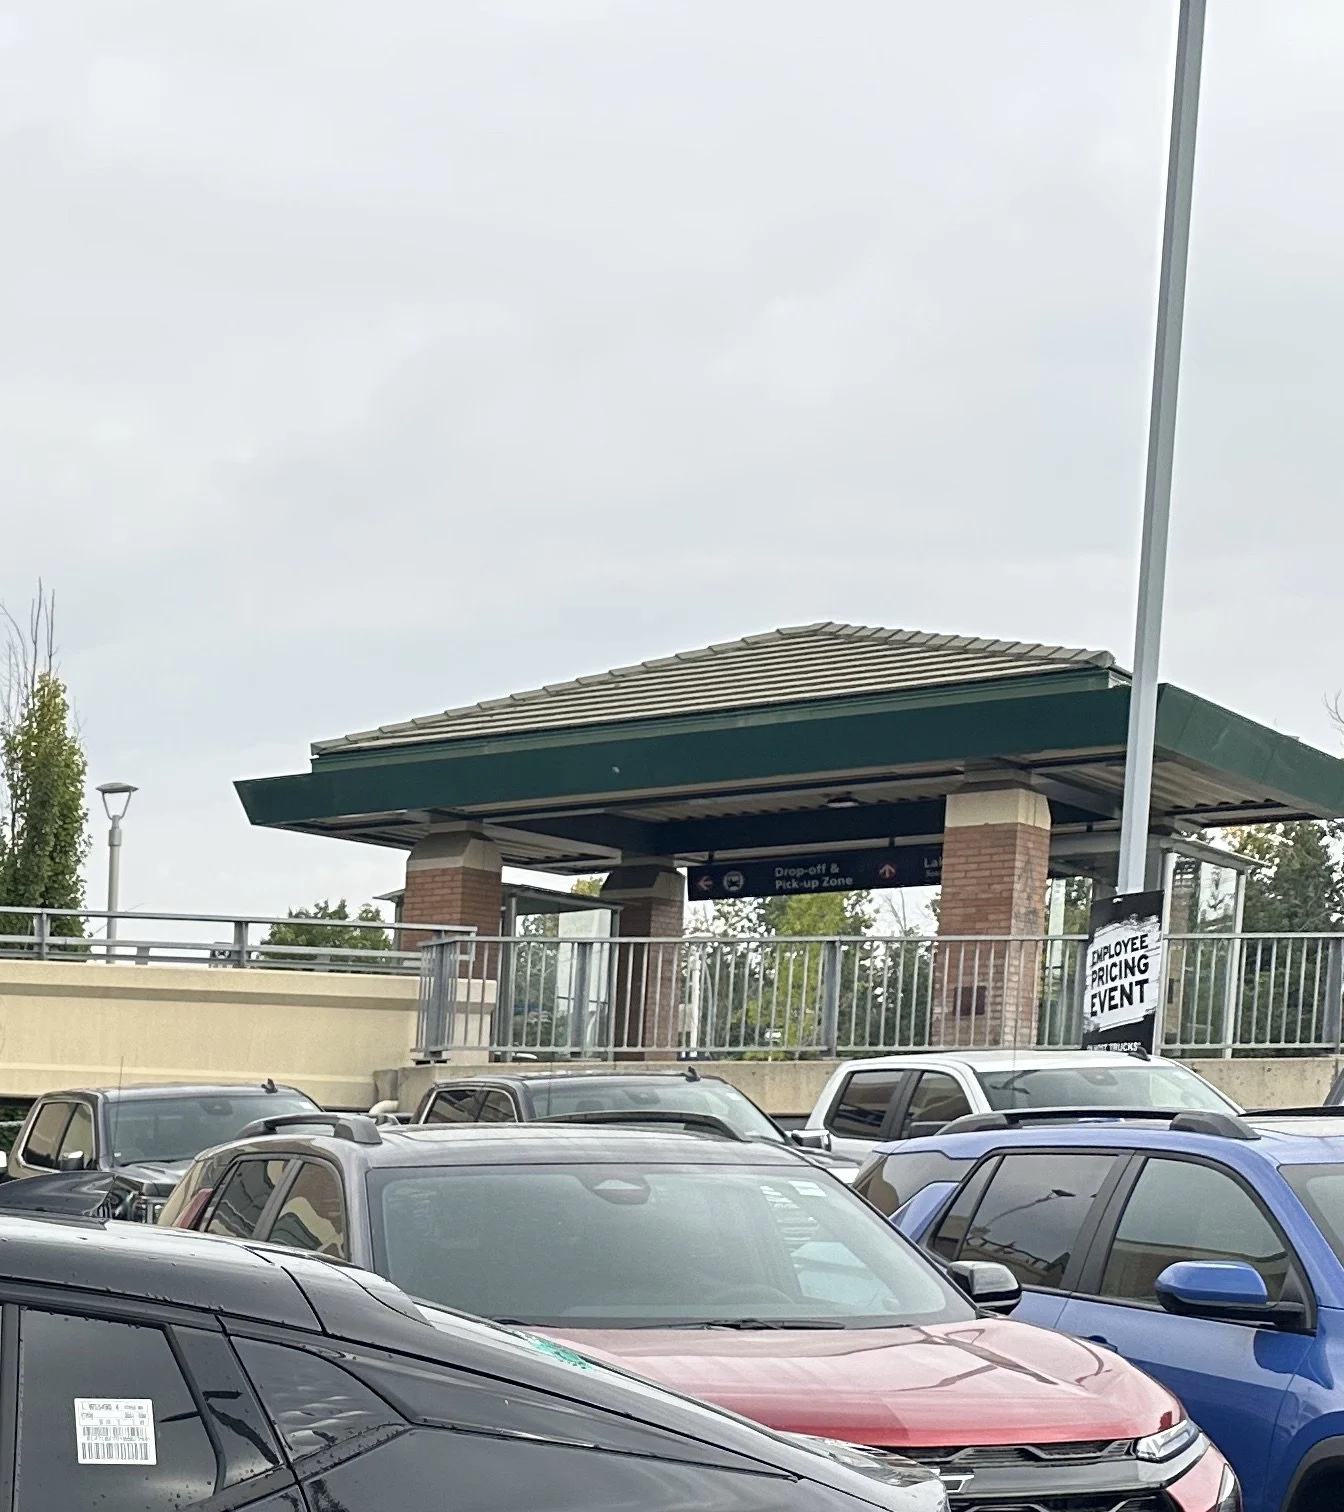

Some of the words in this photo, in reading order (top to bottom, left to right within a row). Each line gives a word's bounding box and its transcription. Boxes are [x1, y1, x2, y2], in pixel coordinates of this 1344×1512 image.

[774, 864, 826, 879] Drop-off
[830, 863, 840, 874] &
[775, 878, 820, 890] Pick-up
[822, 876, 854, 887] Zone
[1091, 933, 1149, 967] EMPLOYEE
[1091, 953, 1150, 990] PRICING
[1090, 978, 1149, 1017] EVENT
